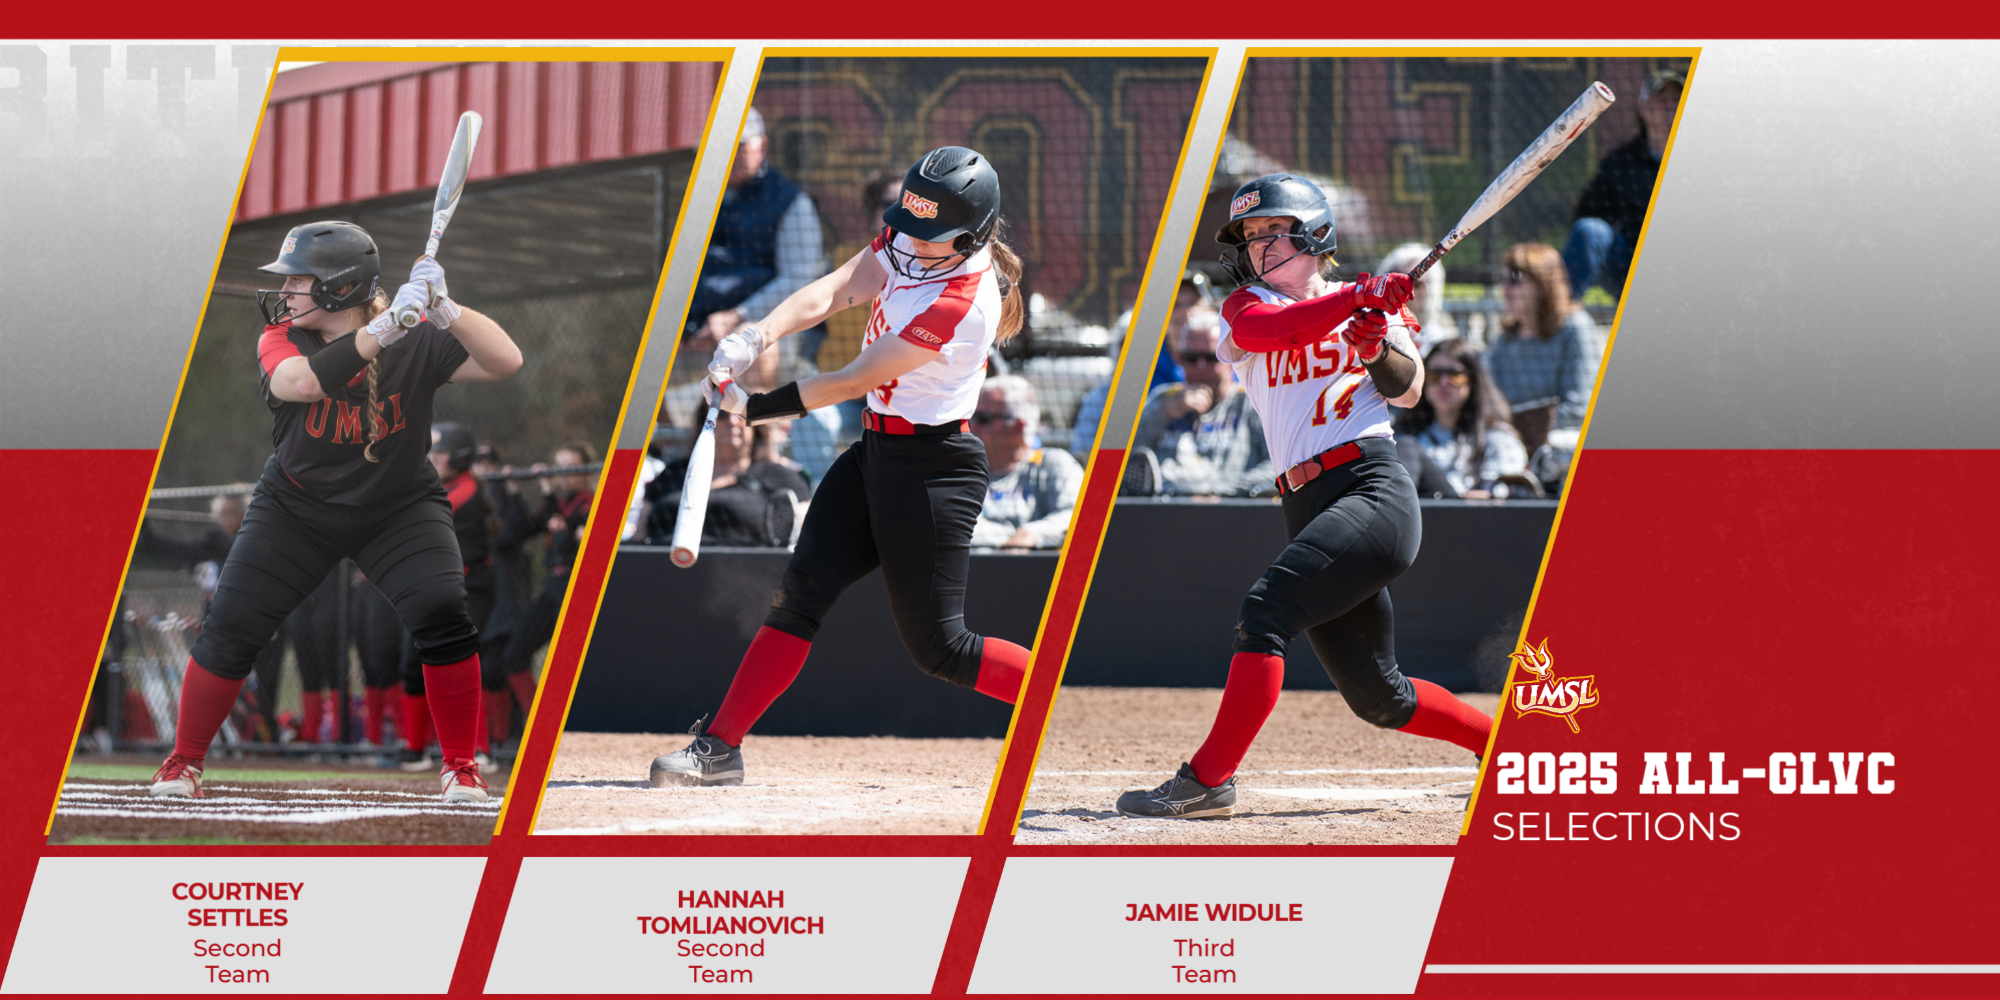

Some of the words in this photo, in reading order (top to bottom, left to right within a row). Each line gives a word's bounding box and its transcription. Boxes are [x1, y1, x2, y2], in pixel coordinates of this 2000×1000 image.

[904, 191, 938, 218] UMSL
[305, 392, 406, 445] UMSL
[1311, 382, 1361, 428] 14
